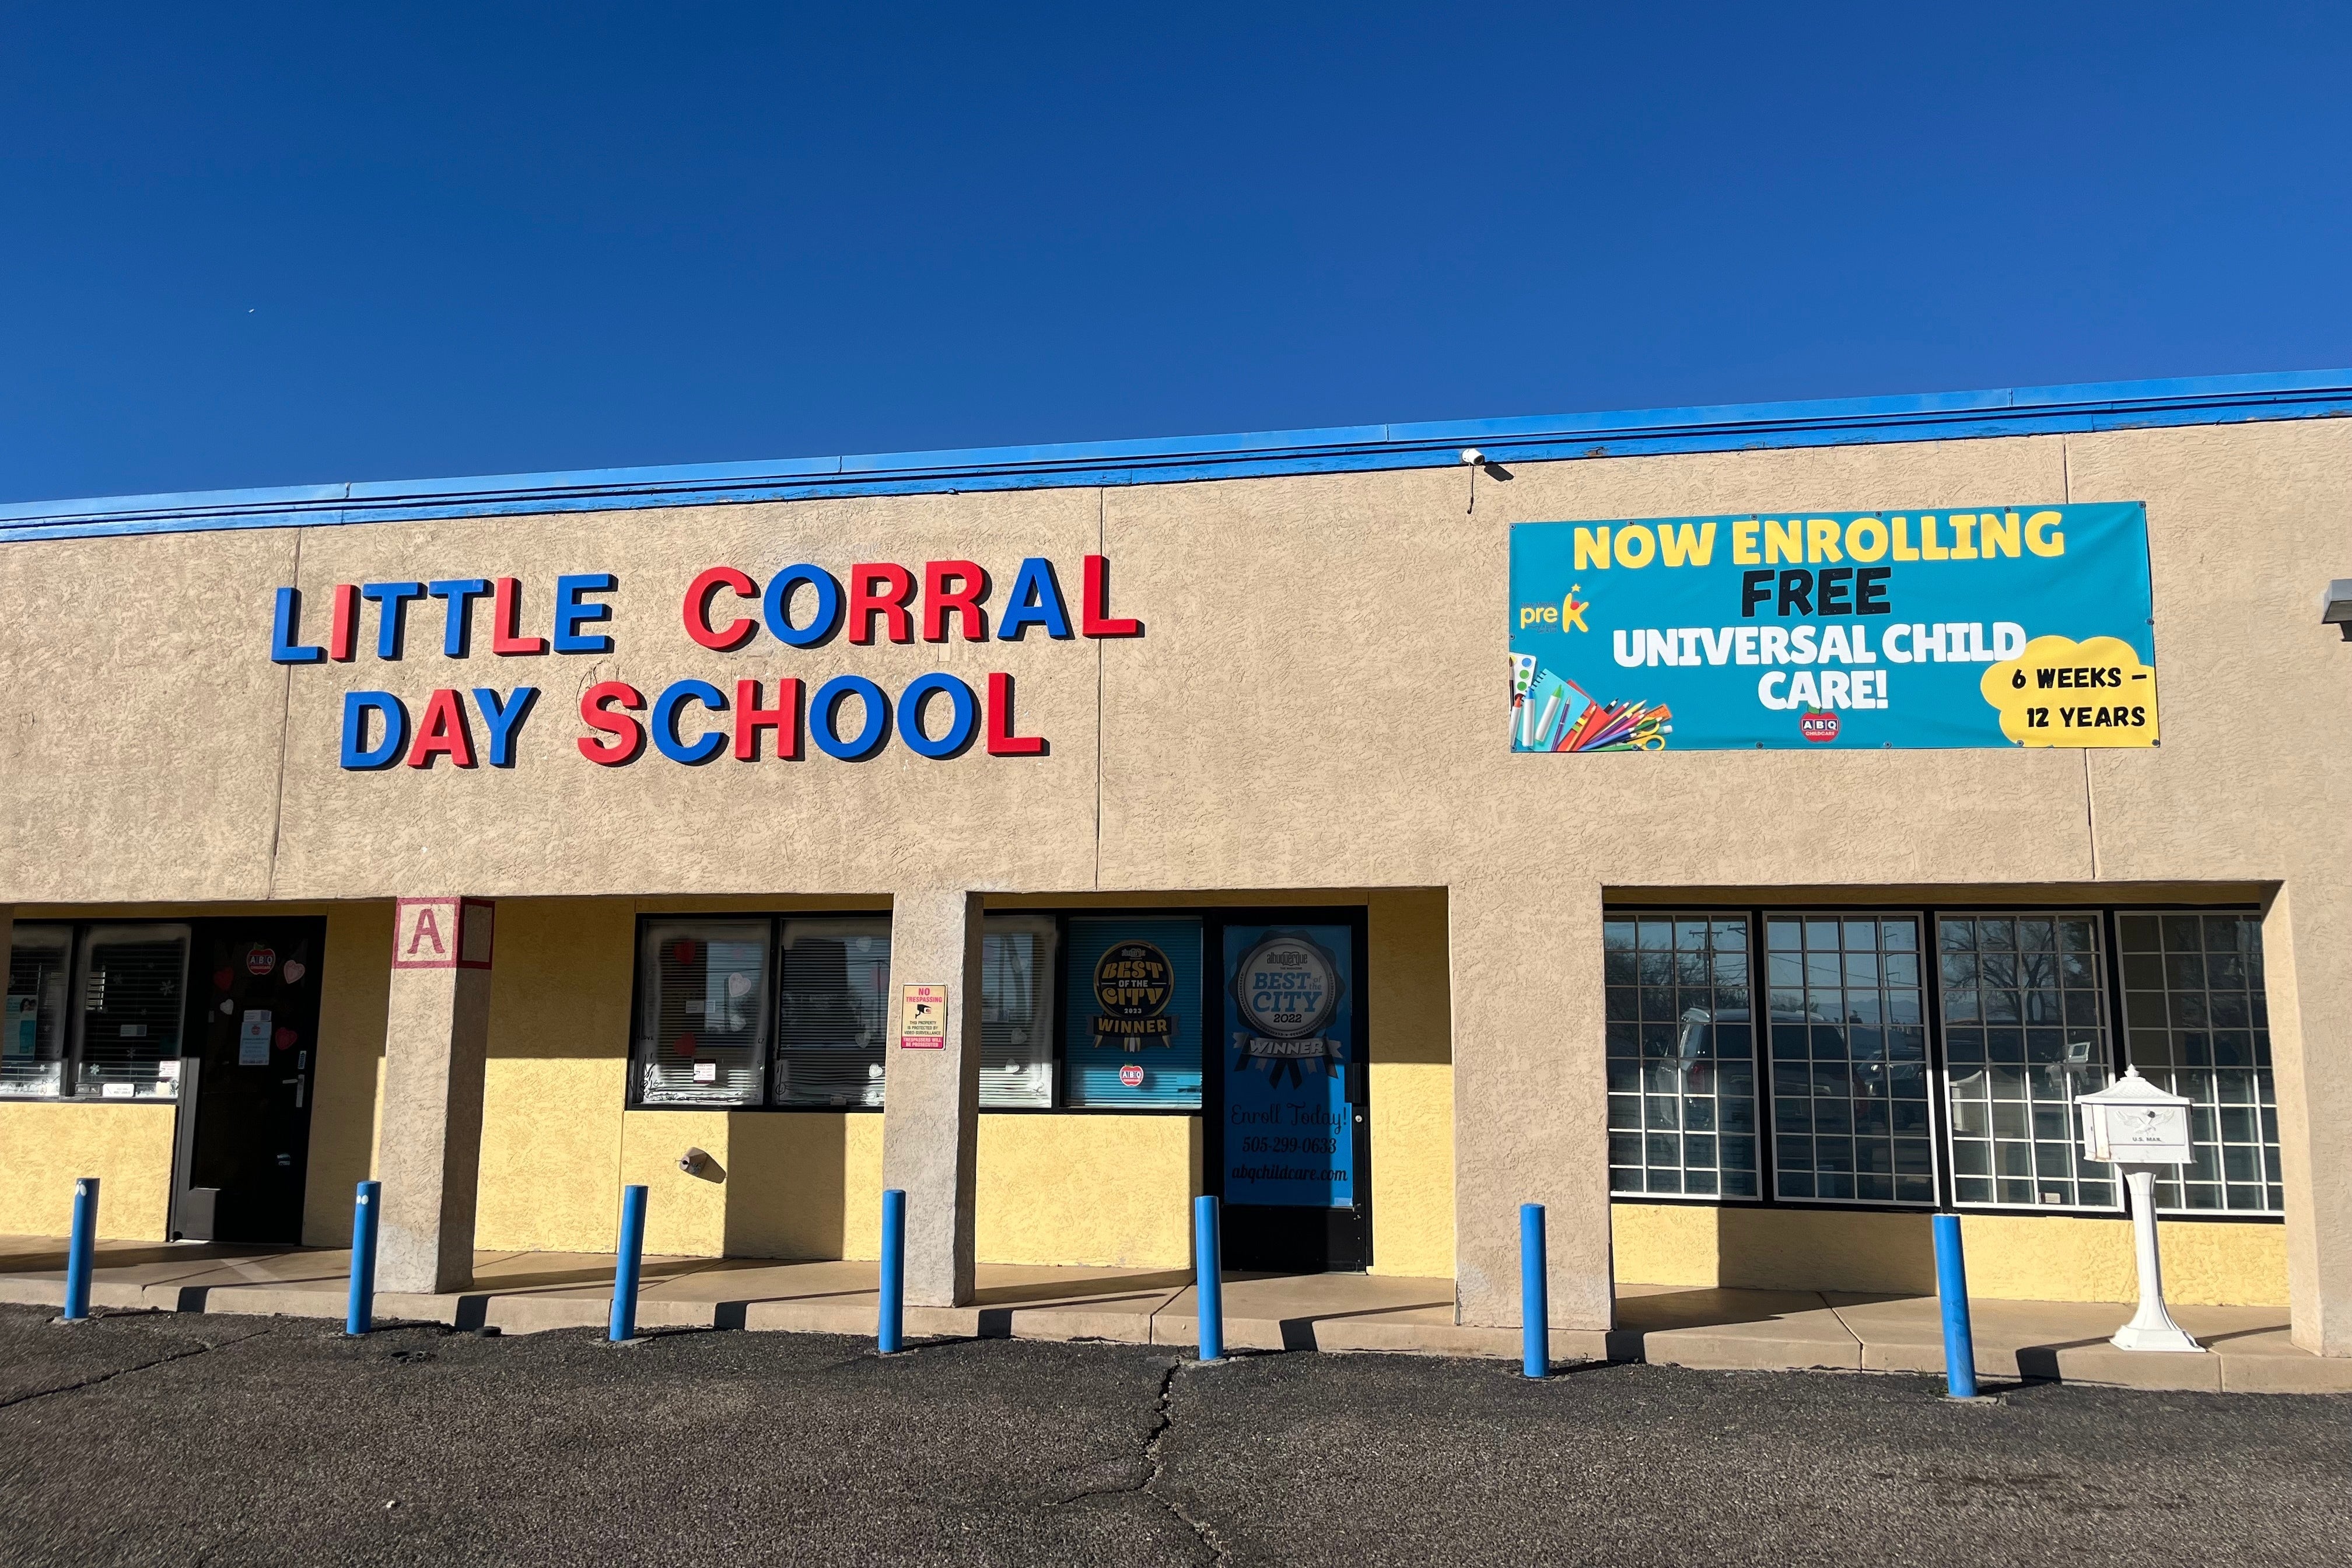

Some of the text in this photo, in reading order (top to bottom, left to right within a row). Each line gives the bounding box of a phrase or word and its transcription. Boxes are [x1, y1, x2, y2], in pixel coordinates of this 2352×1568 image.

[1574, 512, 2064, 570] NOW ENROLLING
[1741, 566, 1892, 618] FREE
[271, 554, 1144, 663] LITTLE CORRAL
[1520, 607, 1558, 629] pre
[1612, 622, 2027, 668] UNIVERSAL CHILD
[2012, 668, 2027, 689] 6
[2036, 667, 2122, 689] WEEKS
[1758, 670, 1888, 710] CARE!
[340, 672, 1048, 769] DAY SCHOOL
[1803, 720, 1837, 730] ABQ
[2027, 706, 2146, 728] 12 YEARS
[407, 908, 445, 954] A
[250, 956, 273, 965] ABQ
[1266, 951, 1308, 966] albuquerque
[1101, 961, 1164, 979] BEST
[1252, 972, 1311, 990] BEST
[918, 988, 930, 996] NO
[1102, 988, 1164, 1006] CITY
[1252, 991, 1322, 1013] CITY
[1098, 1018, 1167, 1034] WINNER
[1273, 1013, 1303, 1023] 2022
[1250, 1040, 1324, 1055] WINNER
[1122, 1071, 1142, 1079] ABQ
[1231, 1101, 1347, 1135] Enroll Today!
[1242, 1136, 1337, 1154] 505-299-0633
[1231, 1164, 1348, 1184] abqchildcare.com
